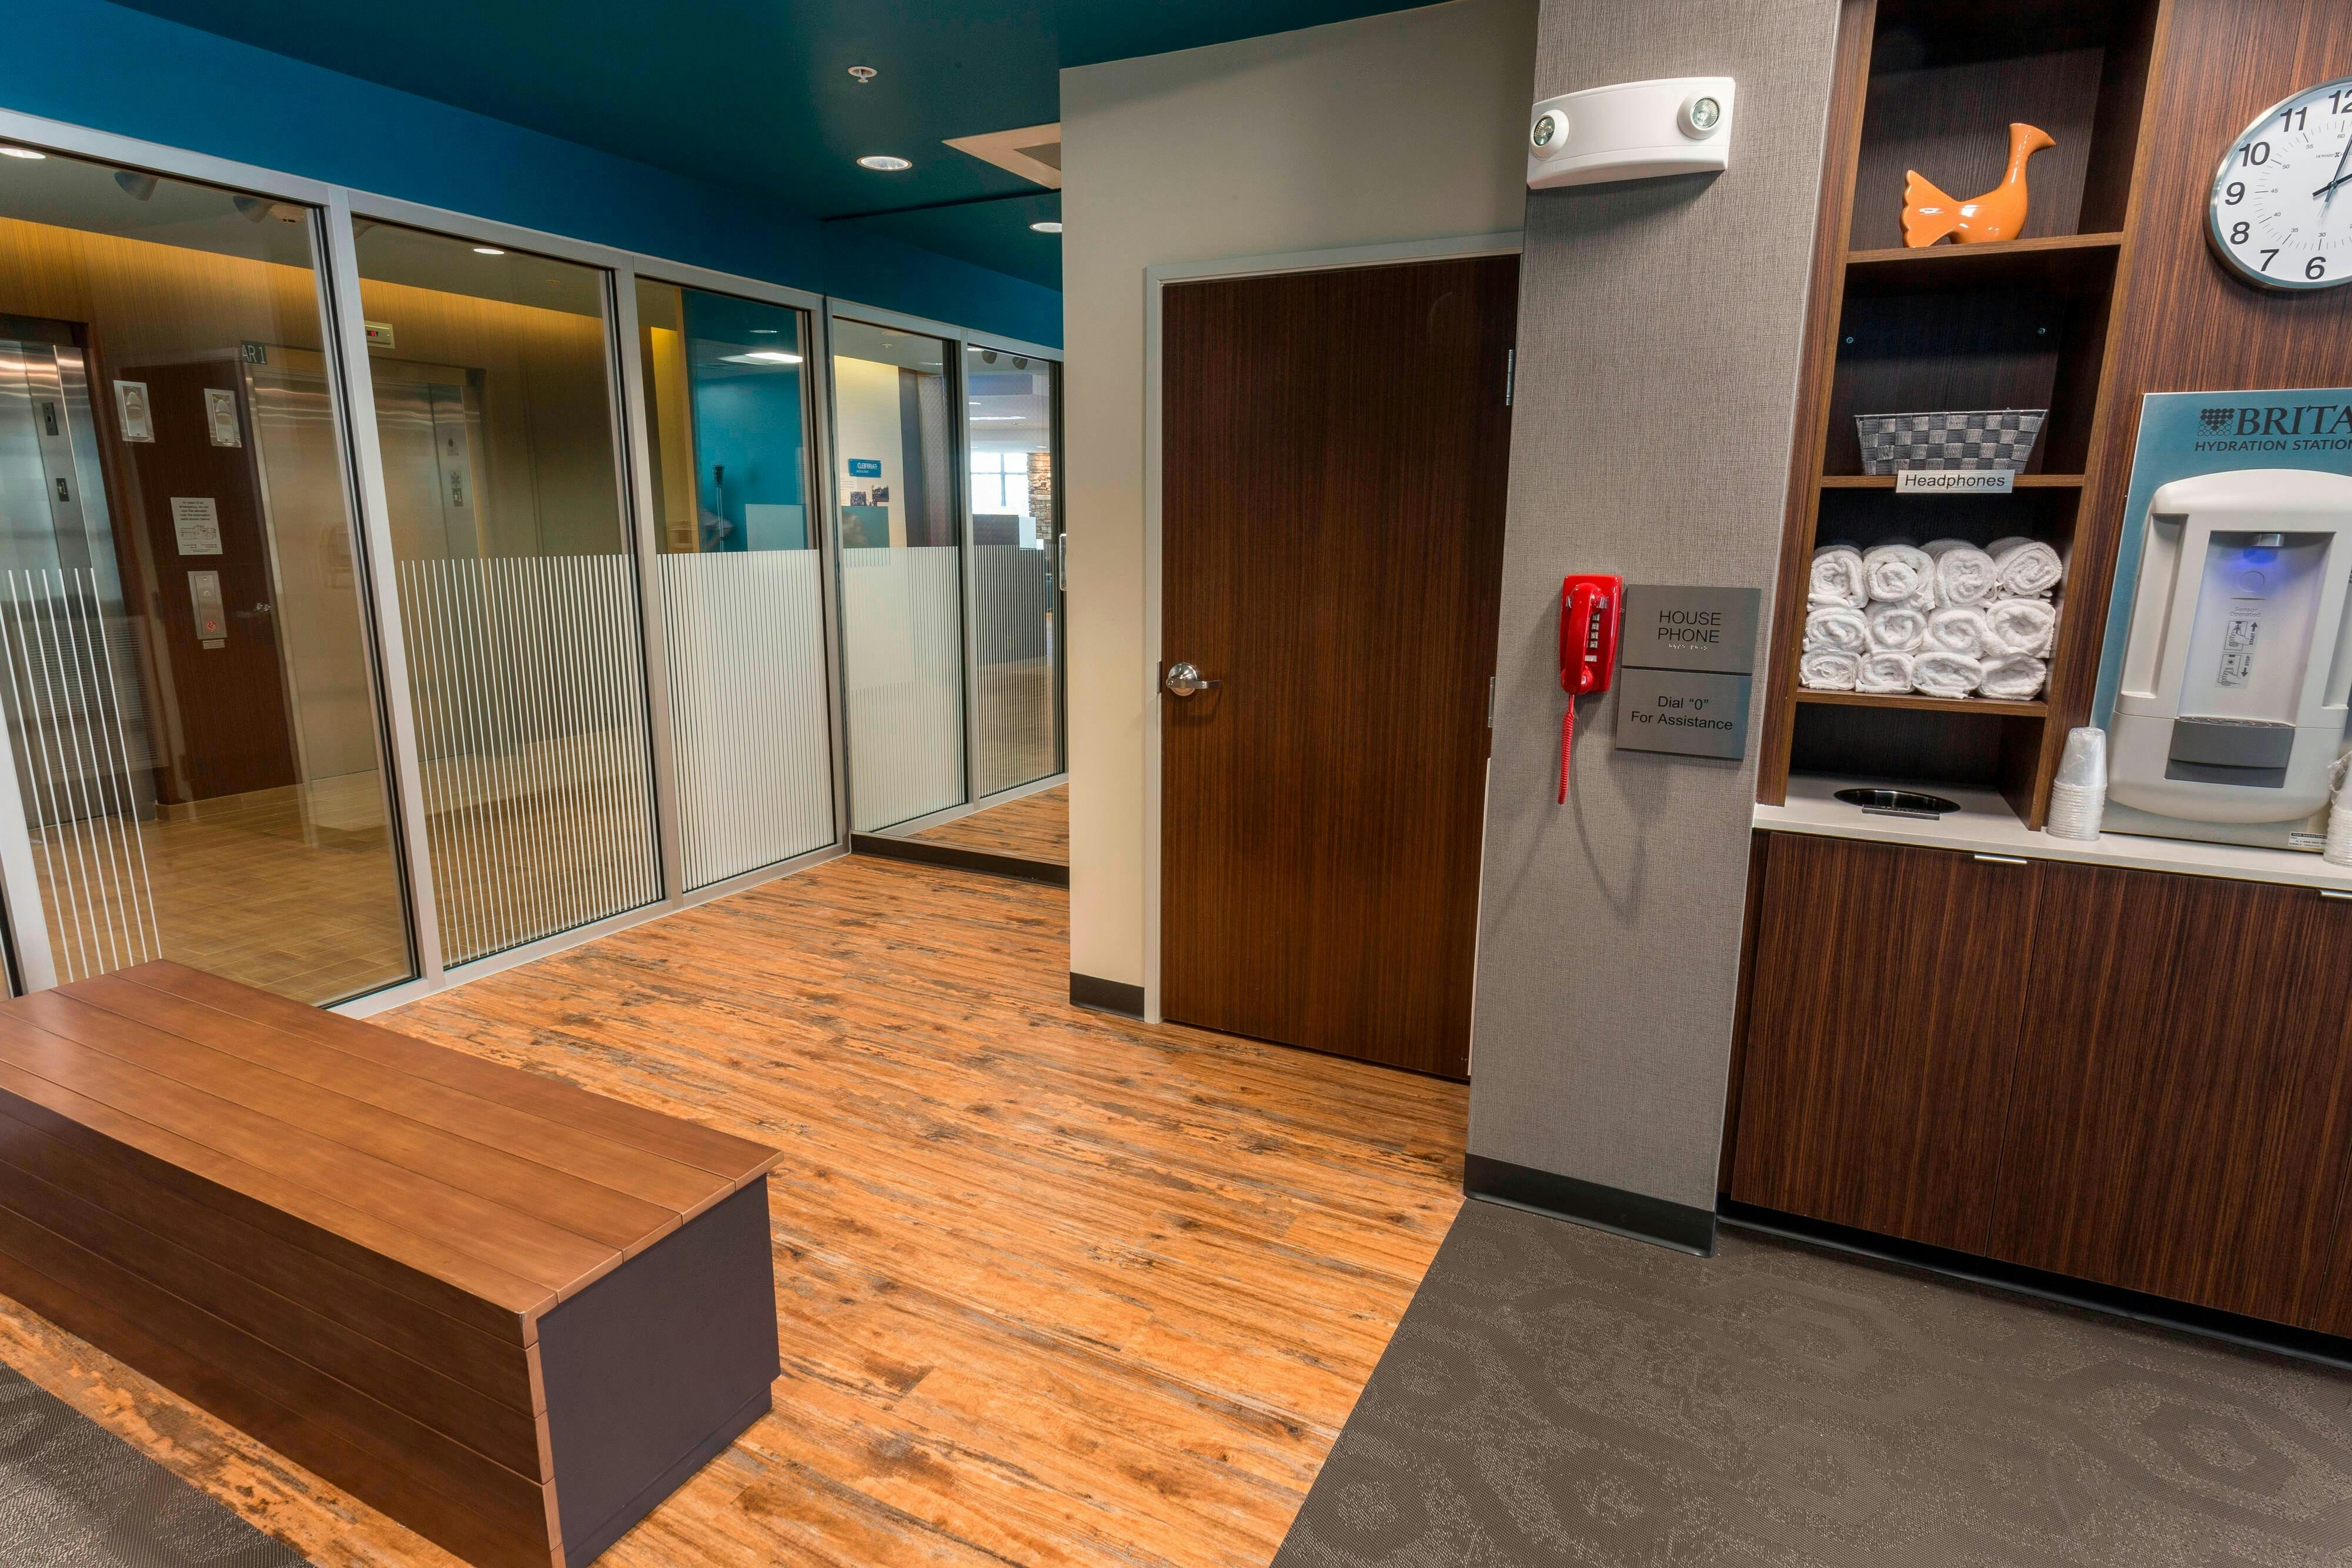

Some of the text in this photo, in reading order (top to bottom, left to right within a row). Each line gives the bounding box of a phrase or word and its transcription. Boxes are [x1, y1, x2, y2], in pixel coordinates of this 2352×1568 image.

[2280, 106, 2307, 132] 11
[2239, 141, 2270, 167] 10
[2225, 182, 2245, 205] 9
[2230, 221, 2250, 245] 8
[2260, 249, 2280, 272] 7
[2305, 256, 2326, 280] 6
[259, 346, 266, 363] 1
[2233, 404, 2352, 435] BRITA
[2194, 440, 2287, 452] HYDRATION
[1905, 474, 2005, 489] Headphones
[1659, 610, 1722, 626] HOUSE
[1658, 627, 1720, 643] PHONE
[1658, 696, 1684, 708] Dial
[1631, 711, 1733, 730] For Assistance
